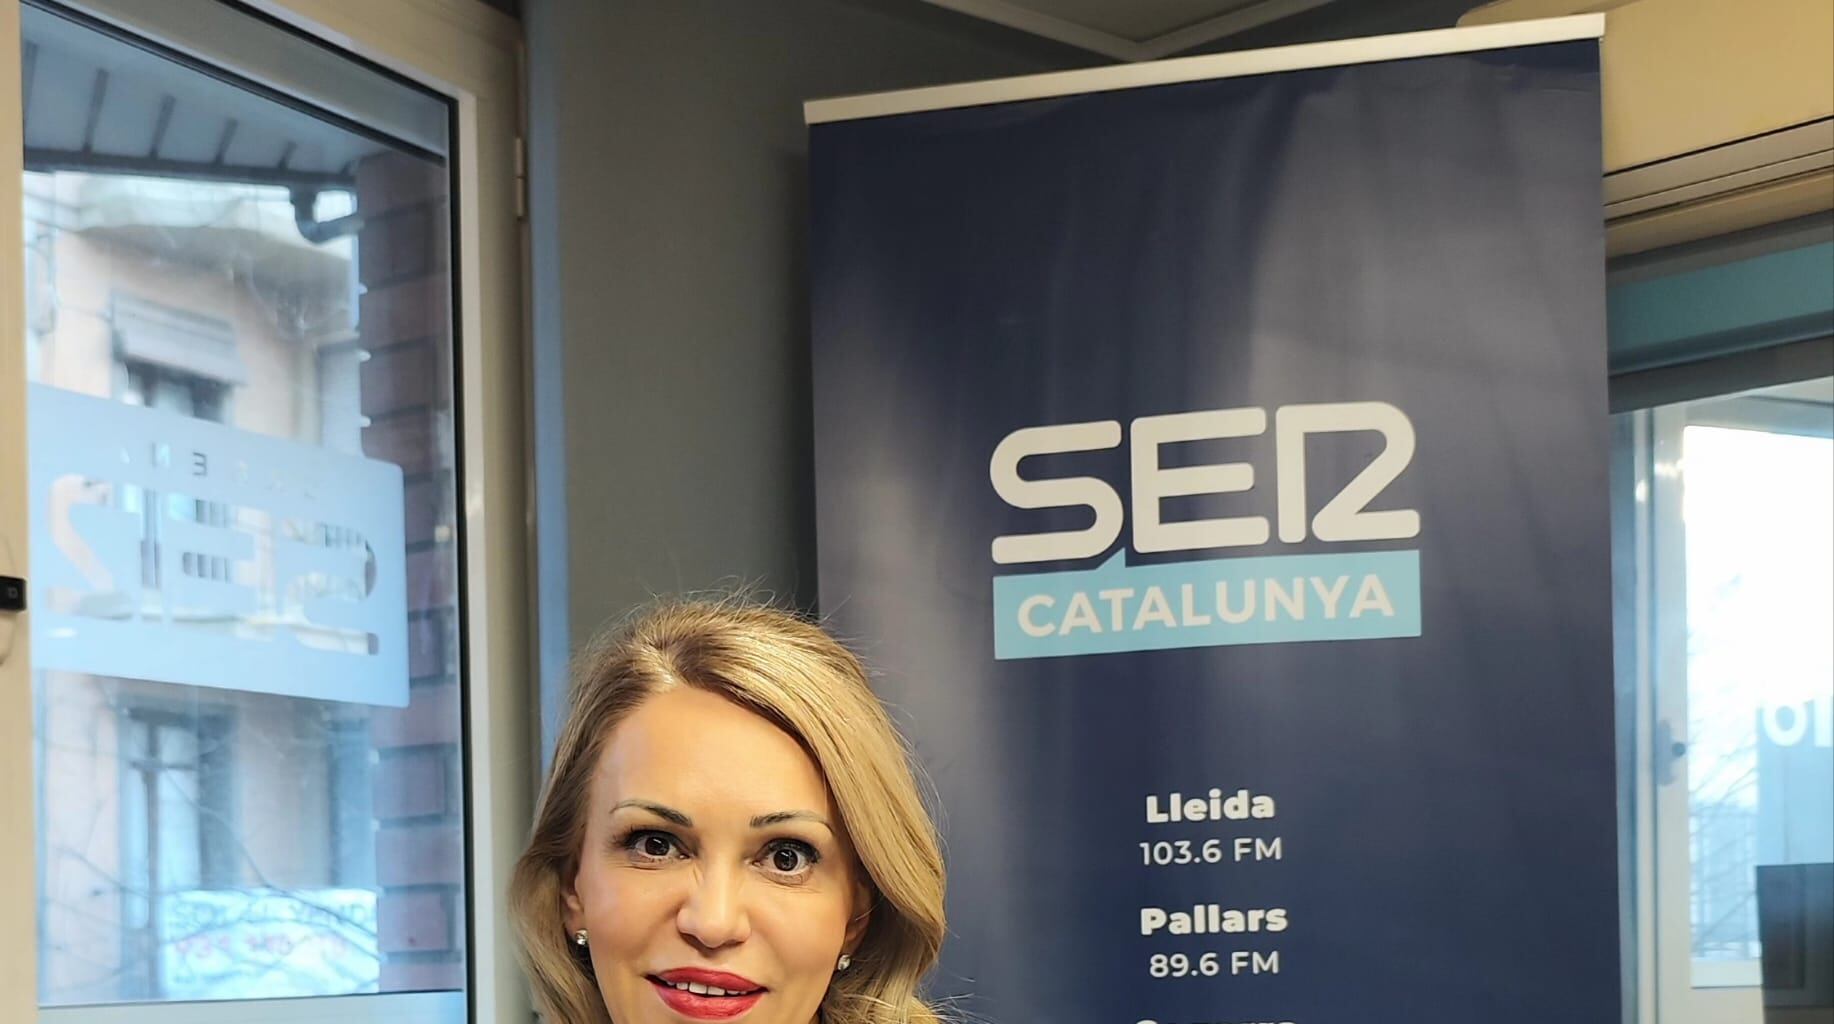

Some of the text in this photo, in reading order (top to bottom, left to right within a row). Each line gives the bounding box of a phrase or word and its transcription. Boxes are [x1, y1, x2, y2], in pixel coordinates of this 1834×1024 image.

[990, 401, 1421, 564] SER
[1016, 573, 1396, 638] CATALUNYA
[1146, 788, 1275, 823] Lleida
[1139, 837, 1282, 865] 103.6 FM
[1140, 904, 1288, 935] Pallars
[1149, 951, 1279, 978] 89.6 FM
